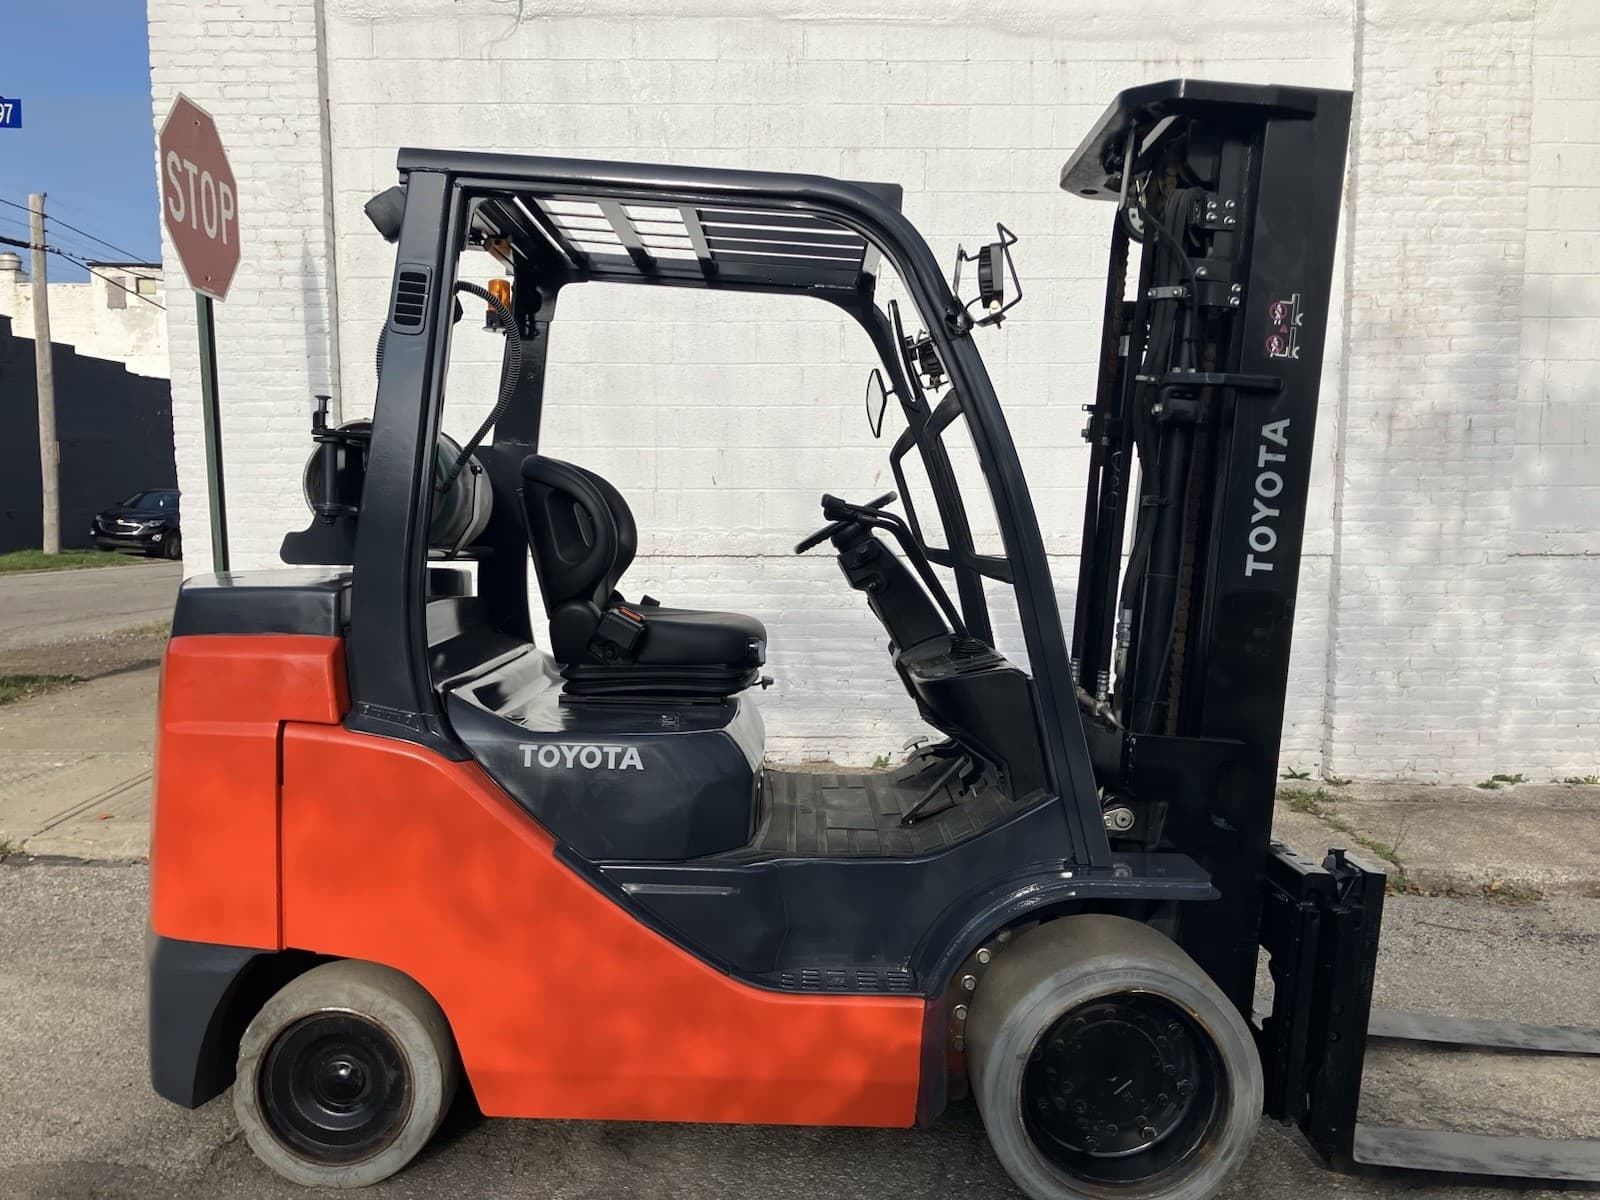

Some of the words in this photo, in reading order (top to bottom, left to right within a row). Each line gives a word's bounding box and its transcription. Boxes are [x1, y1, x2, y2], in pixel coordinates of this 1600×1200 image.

[166, 150, 234, 245] STOP
[1244, 417, 1291, 577] TOYOTA
[518, 744, 645, 771] TOYOTA
